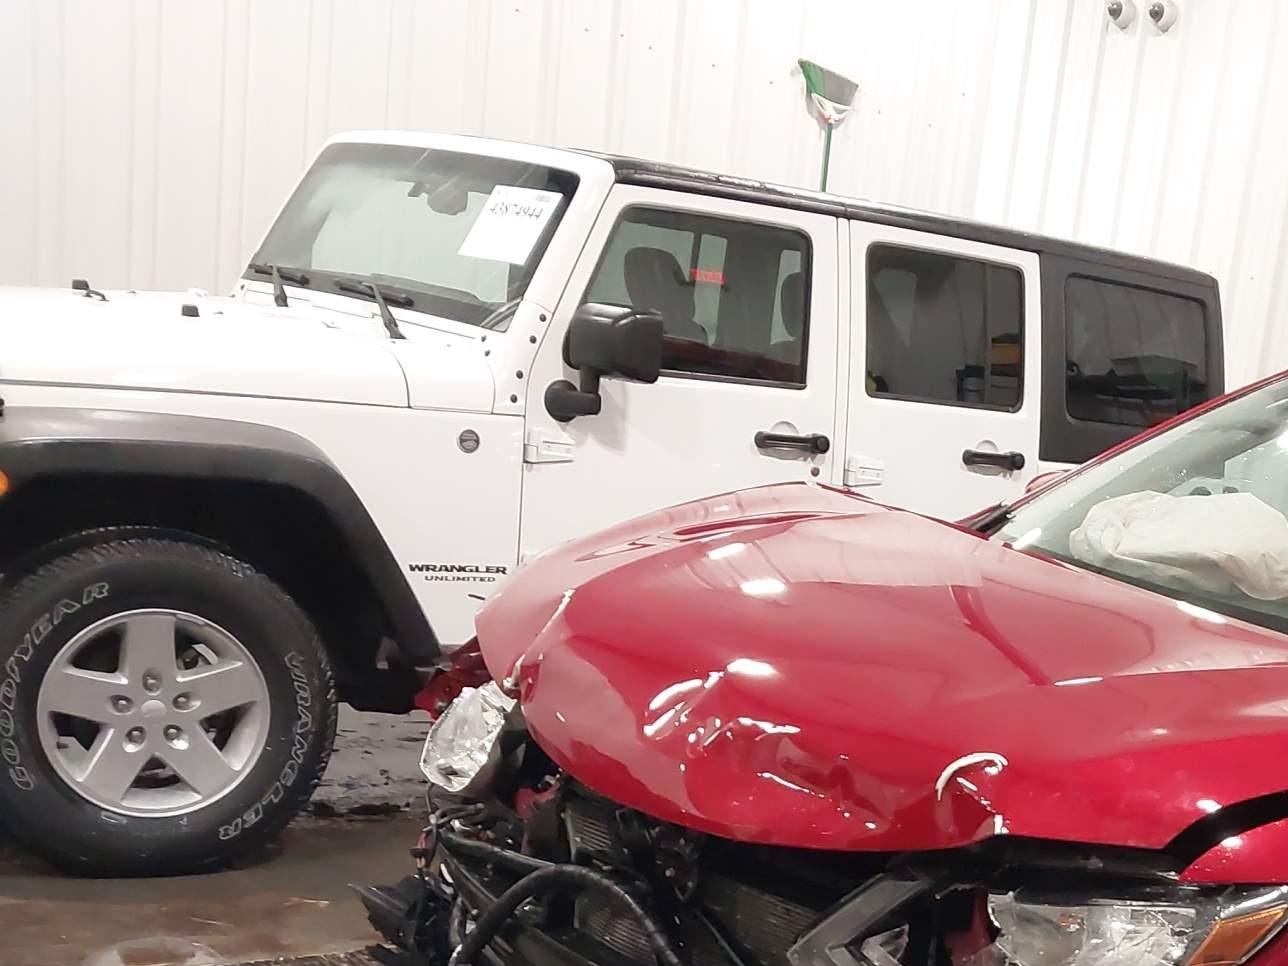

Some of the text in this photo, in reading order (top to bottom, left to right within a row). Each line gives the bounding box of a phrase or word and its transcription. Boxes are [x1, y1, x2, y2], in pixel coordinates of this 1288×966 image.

[408, 564, 507, 575] WRANGLER
[0, 582, 109, 790] GOODYEAR
[218, 651, 312, 840] WRANGLER
